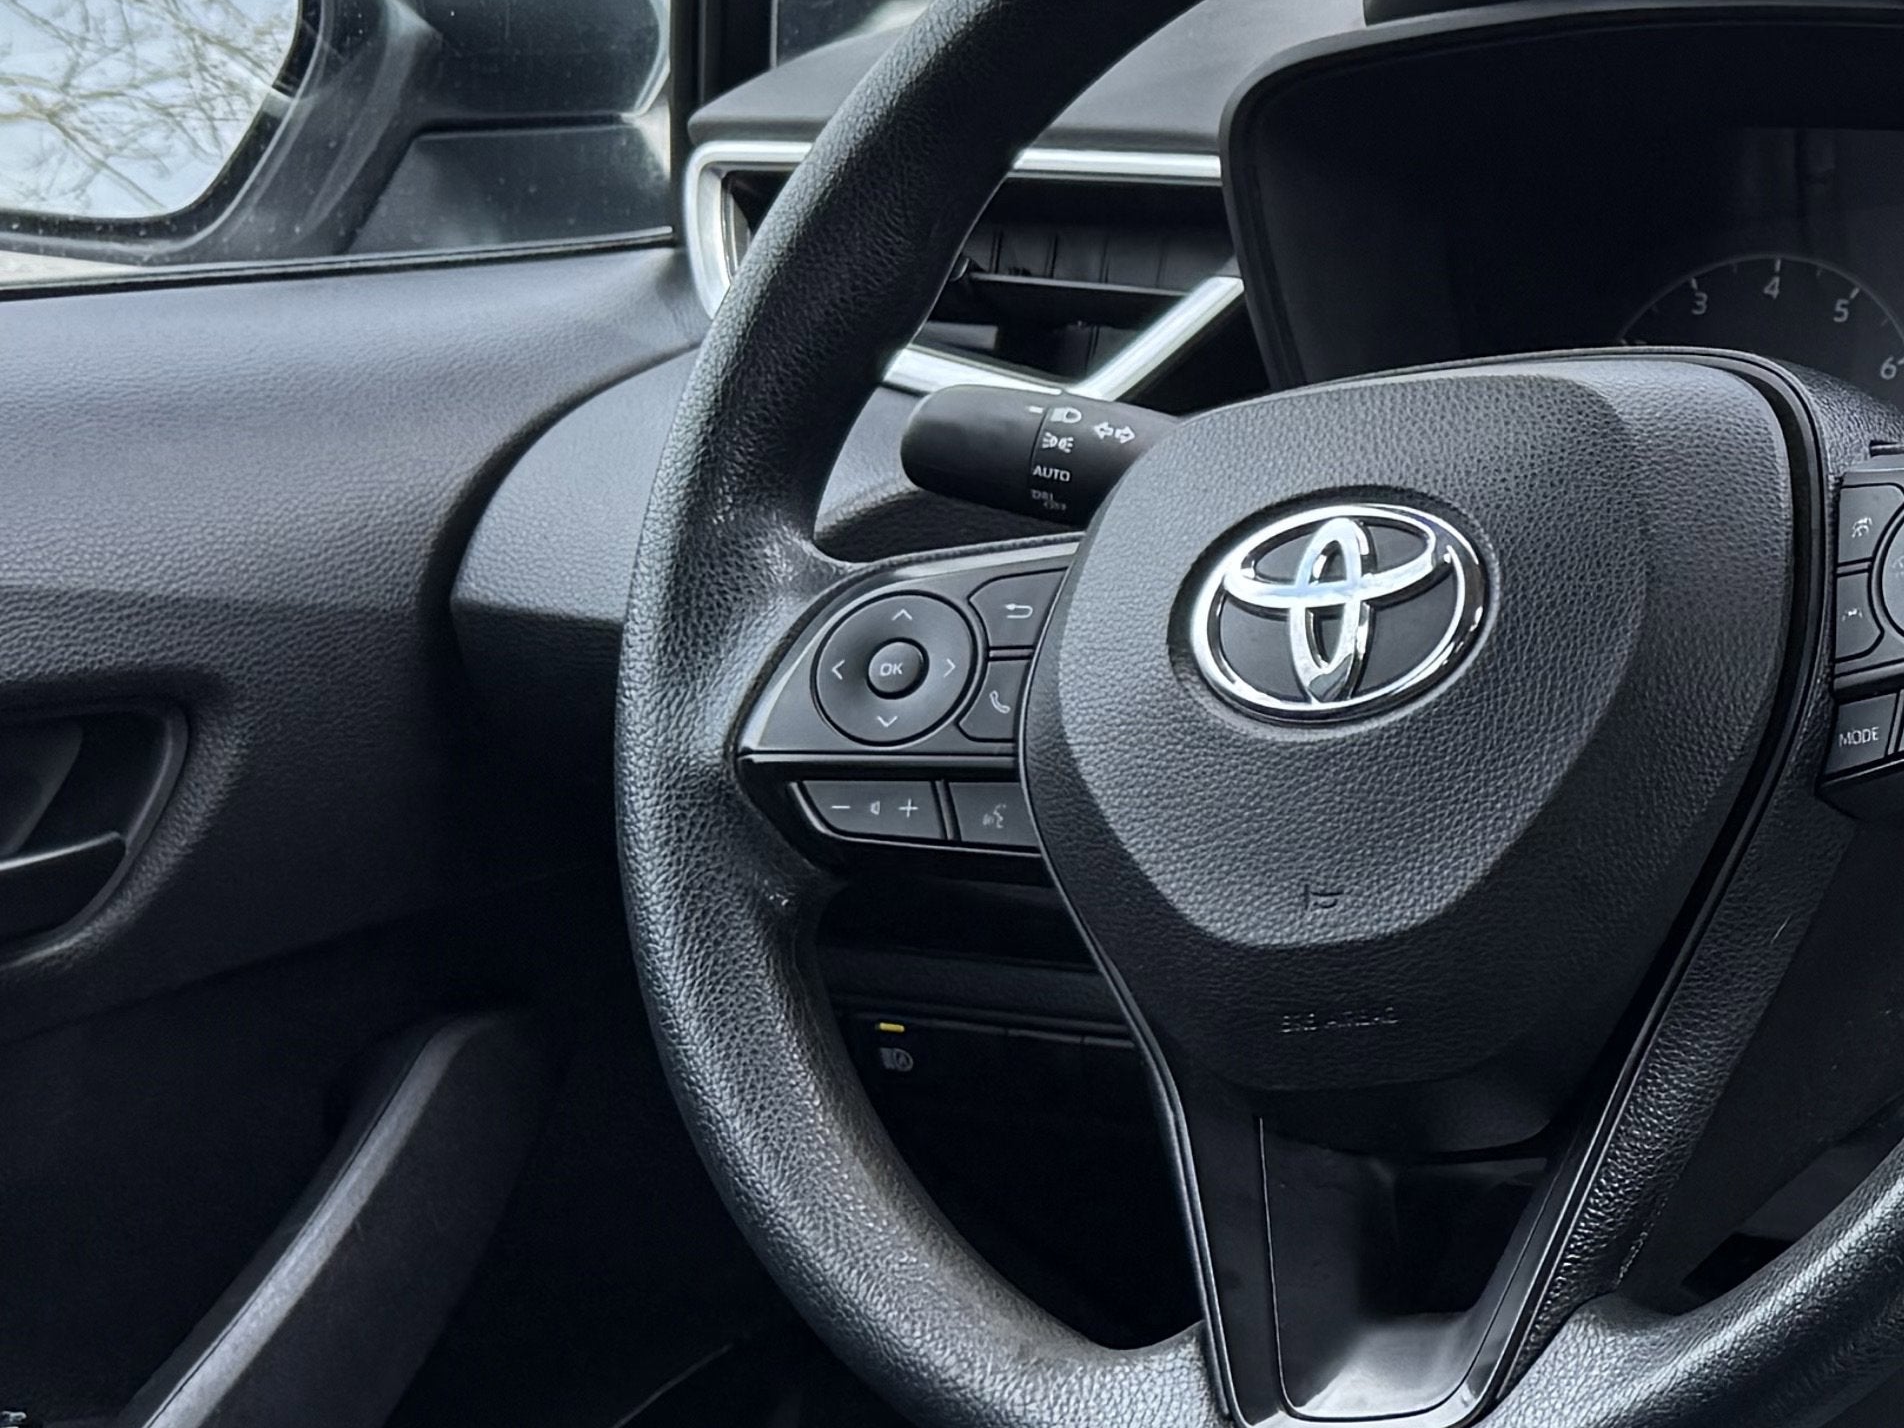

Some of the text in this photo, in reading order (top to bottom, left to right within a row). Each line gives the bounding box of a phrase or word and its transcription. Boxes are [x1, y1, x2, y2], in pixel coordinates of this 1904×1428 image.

[1763, 276, 1781, 300] 4
[1691, 291, 1708, 315] 3
[1832, 298, 1850, 323] 5
[1879, 355, 1898, 381] 6
[1032, 465, 1071, 482] AUTO
[880, 662, 904, 677] OK
[1838, 726, 1880, 748] MODE
